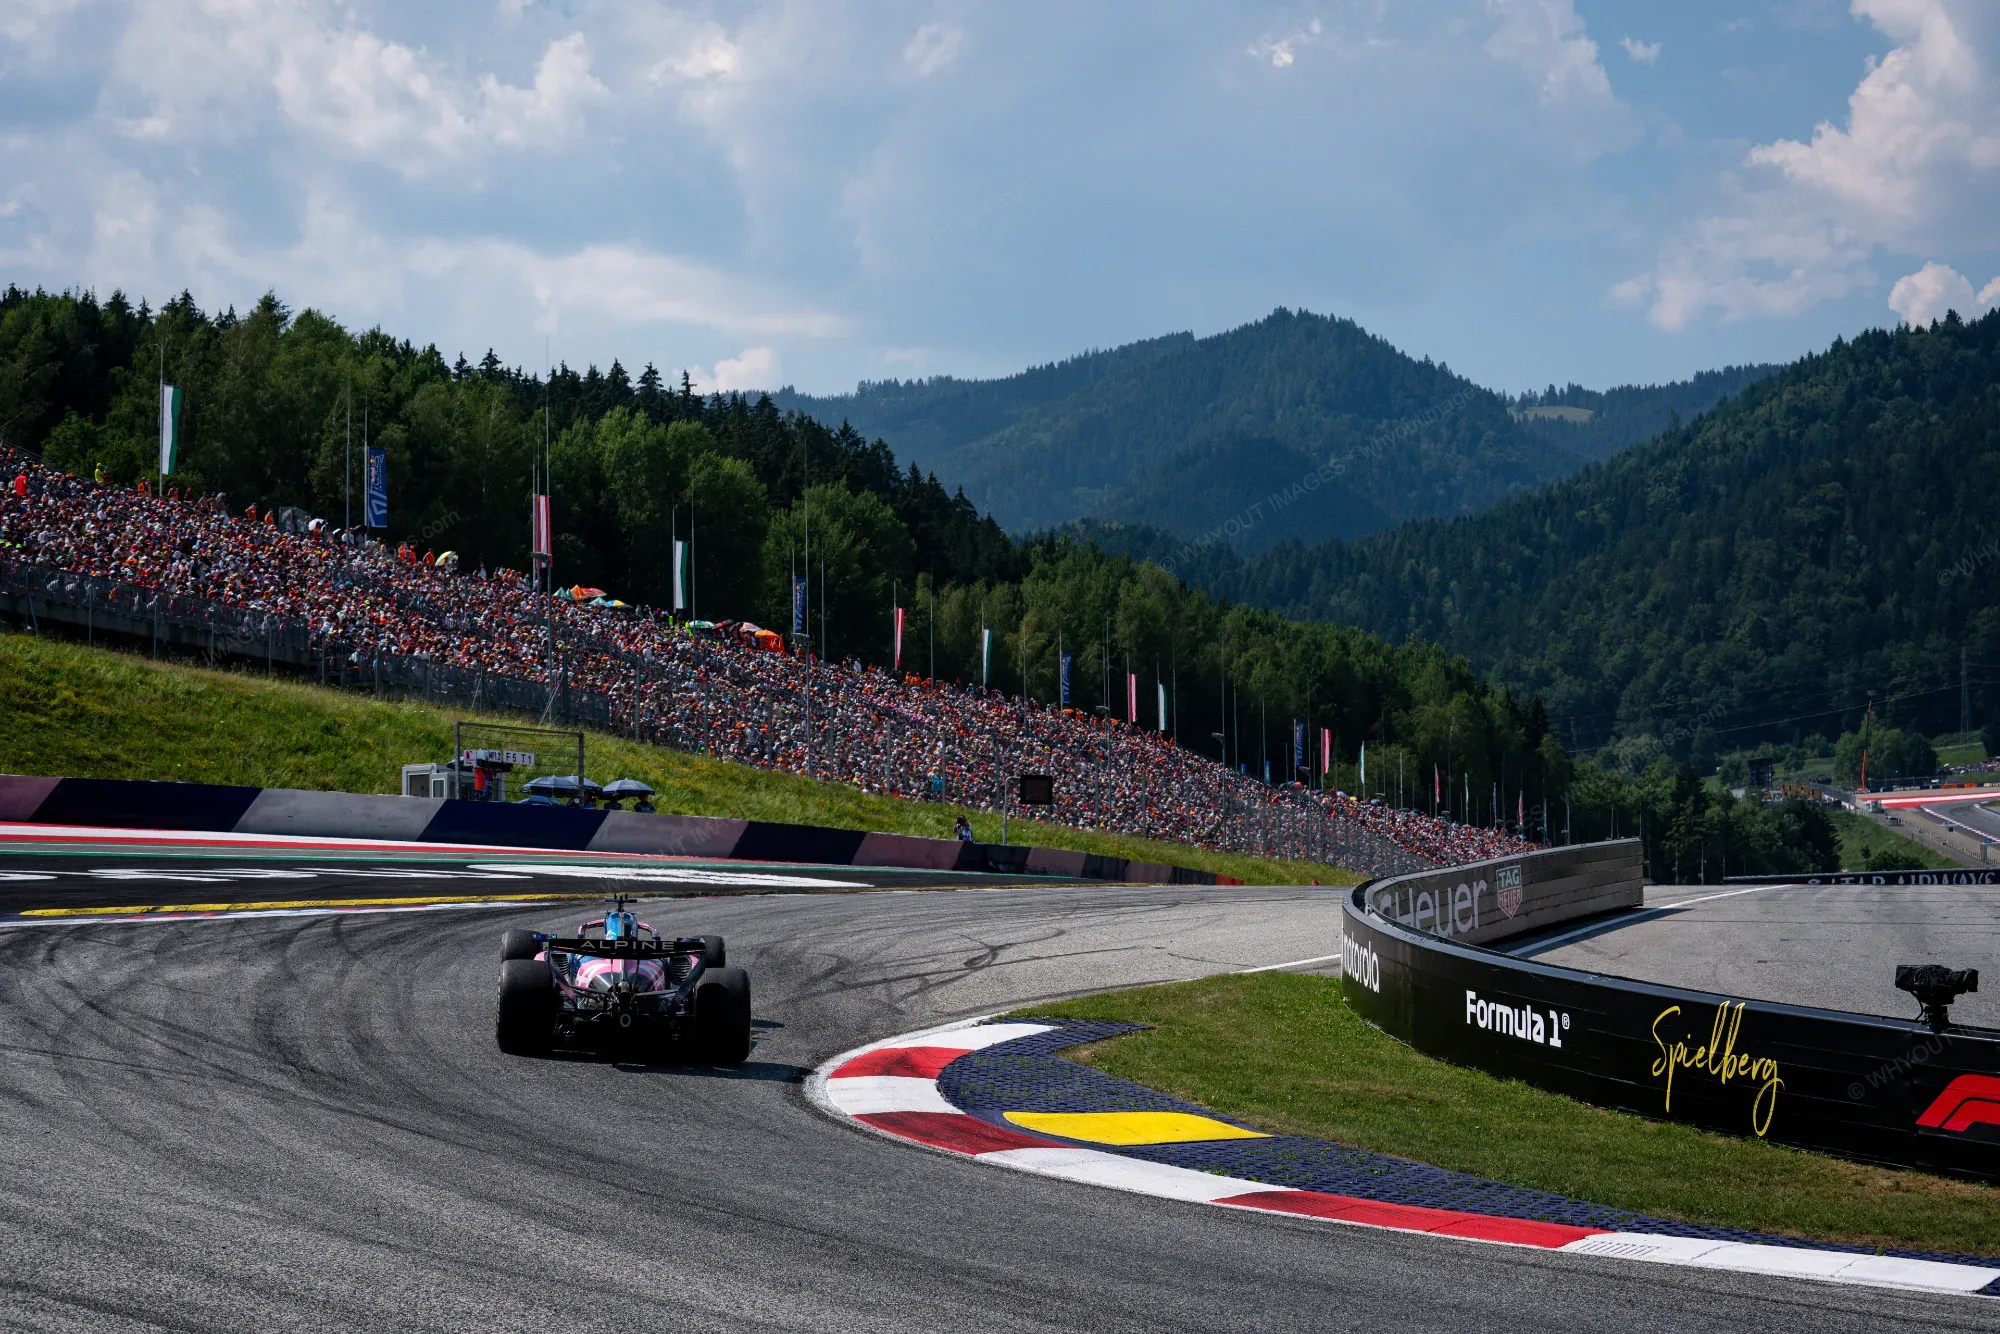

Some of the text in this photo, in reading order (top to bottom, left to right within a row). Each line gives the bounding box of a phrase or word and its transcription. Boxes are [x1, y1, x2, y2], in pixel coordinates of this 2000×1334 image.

[1498, 867, 1520, 888] TAG
[1498, 889, 1521, 914] HEUER
[580, 939, 675, 951] ALPINE
[1466, 990, 1545, 1044] Formula
[1652, 1000, 1785, 1137] Spielberg
